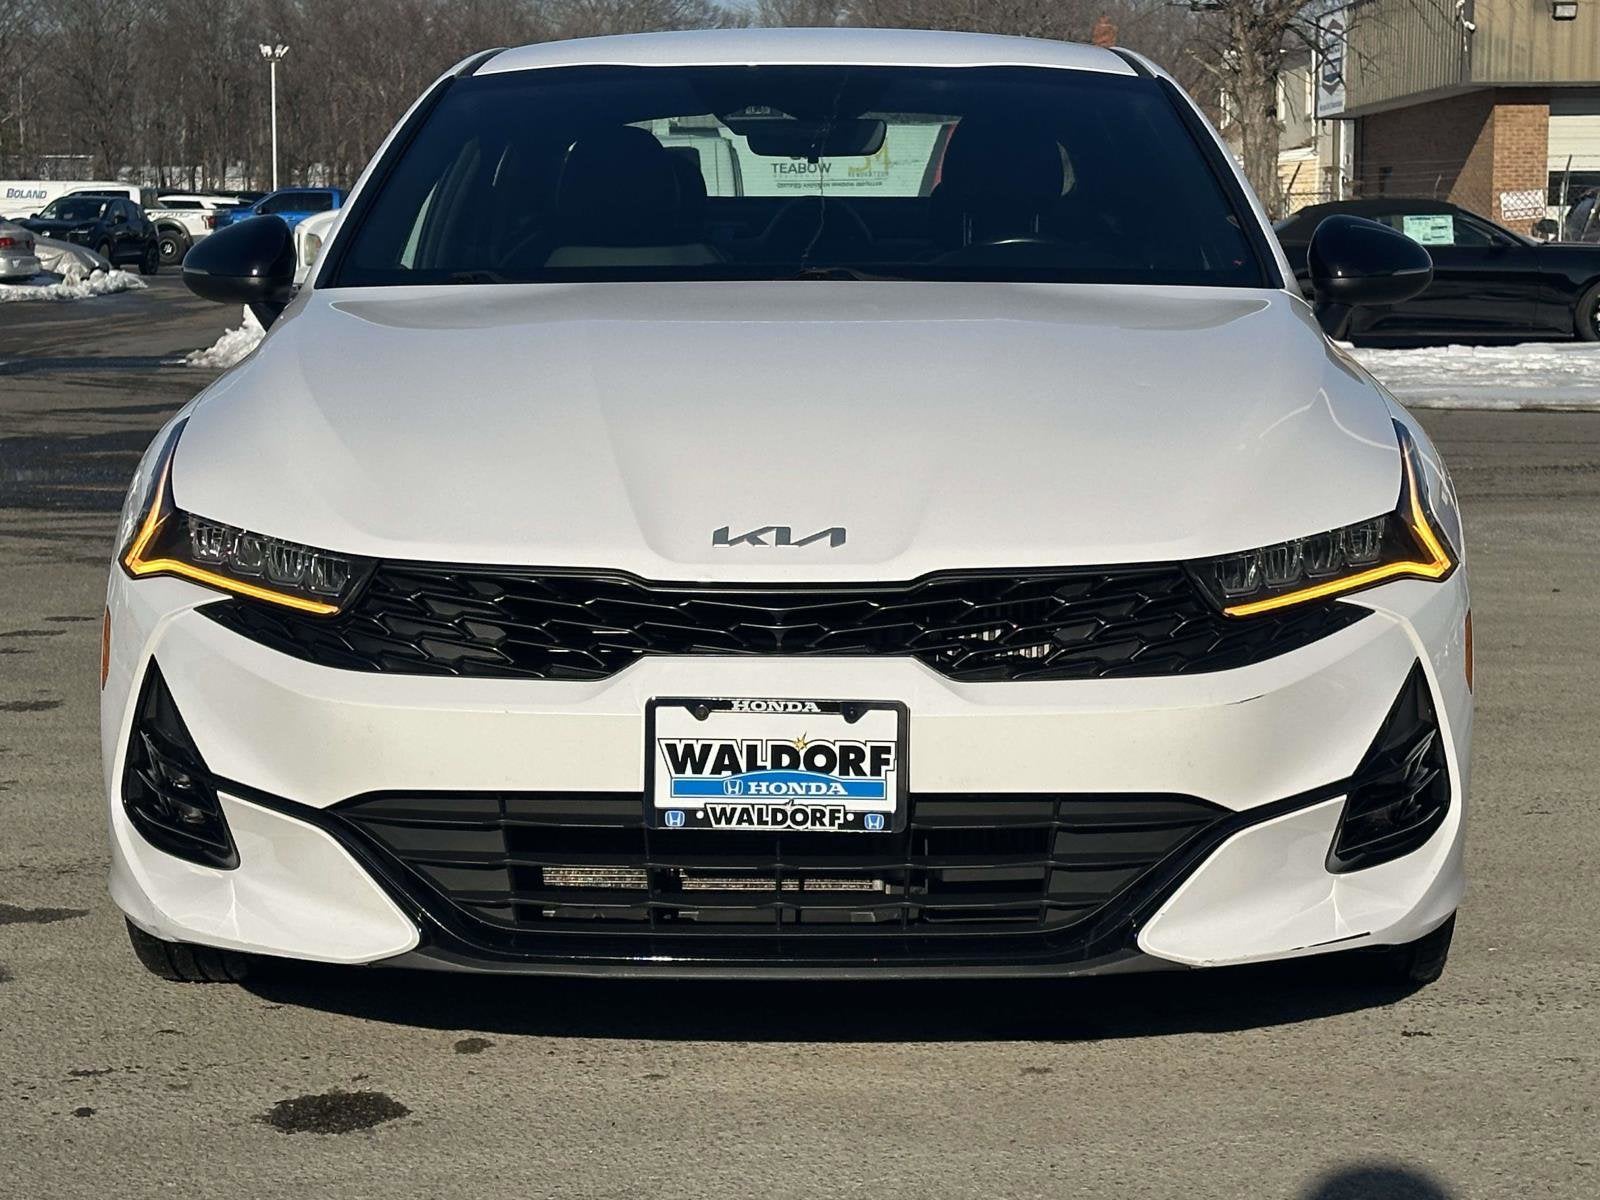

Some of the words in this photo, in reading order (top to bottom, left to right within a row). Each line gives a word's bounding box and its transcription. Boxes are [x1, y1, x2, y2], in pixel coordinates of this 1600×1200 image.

[771, 163, 832, 174] TEABOW
[6, 188, 48, 199] BOLAND
[713, 526, 847, 548] KIA
[731, 700, 821, 713] HONDA
[664, 742, 892, 777] WALDORF
[747, 781, 848, 796] HONDA
[707, 804, 845, 829] WALDORF
